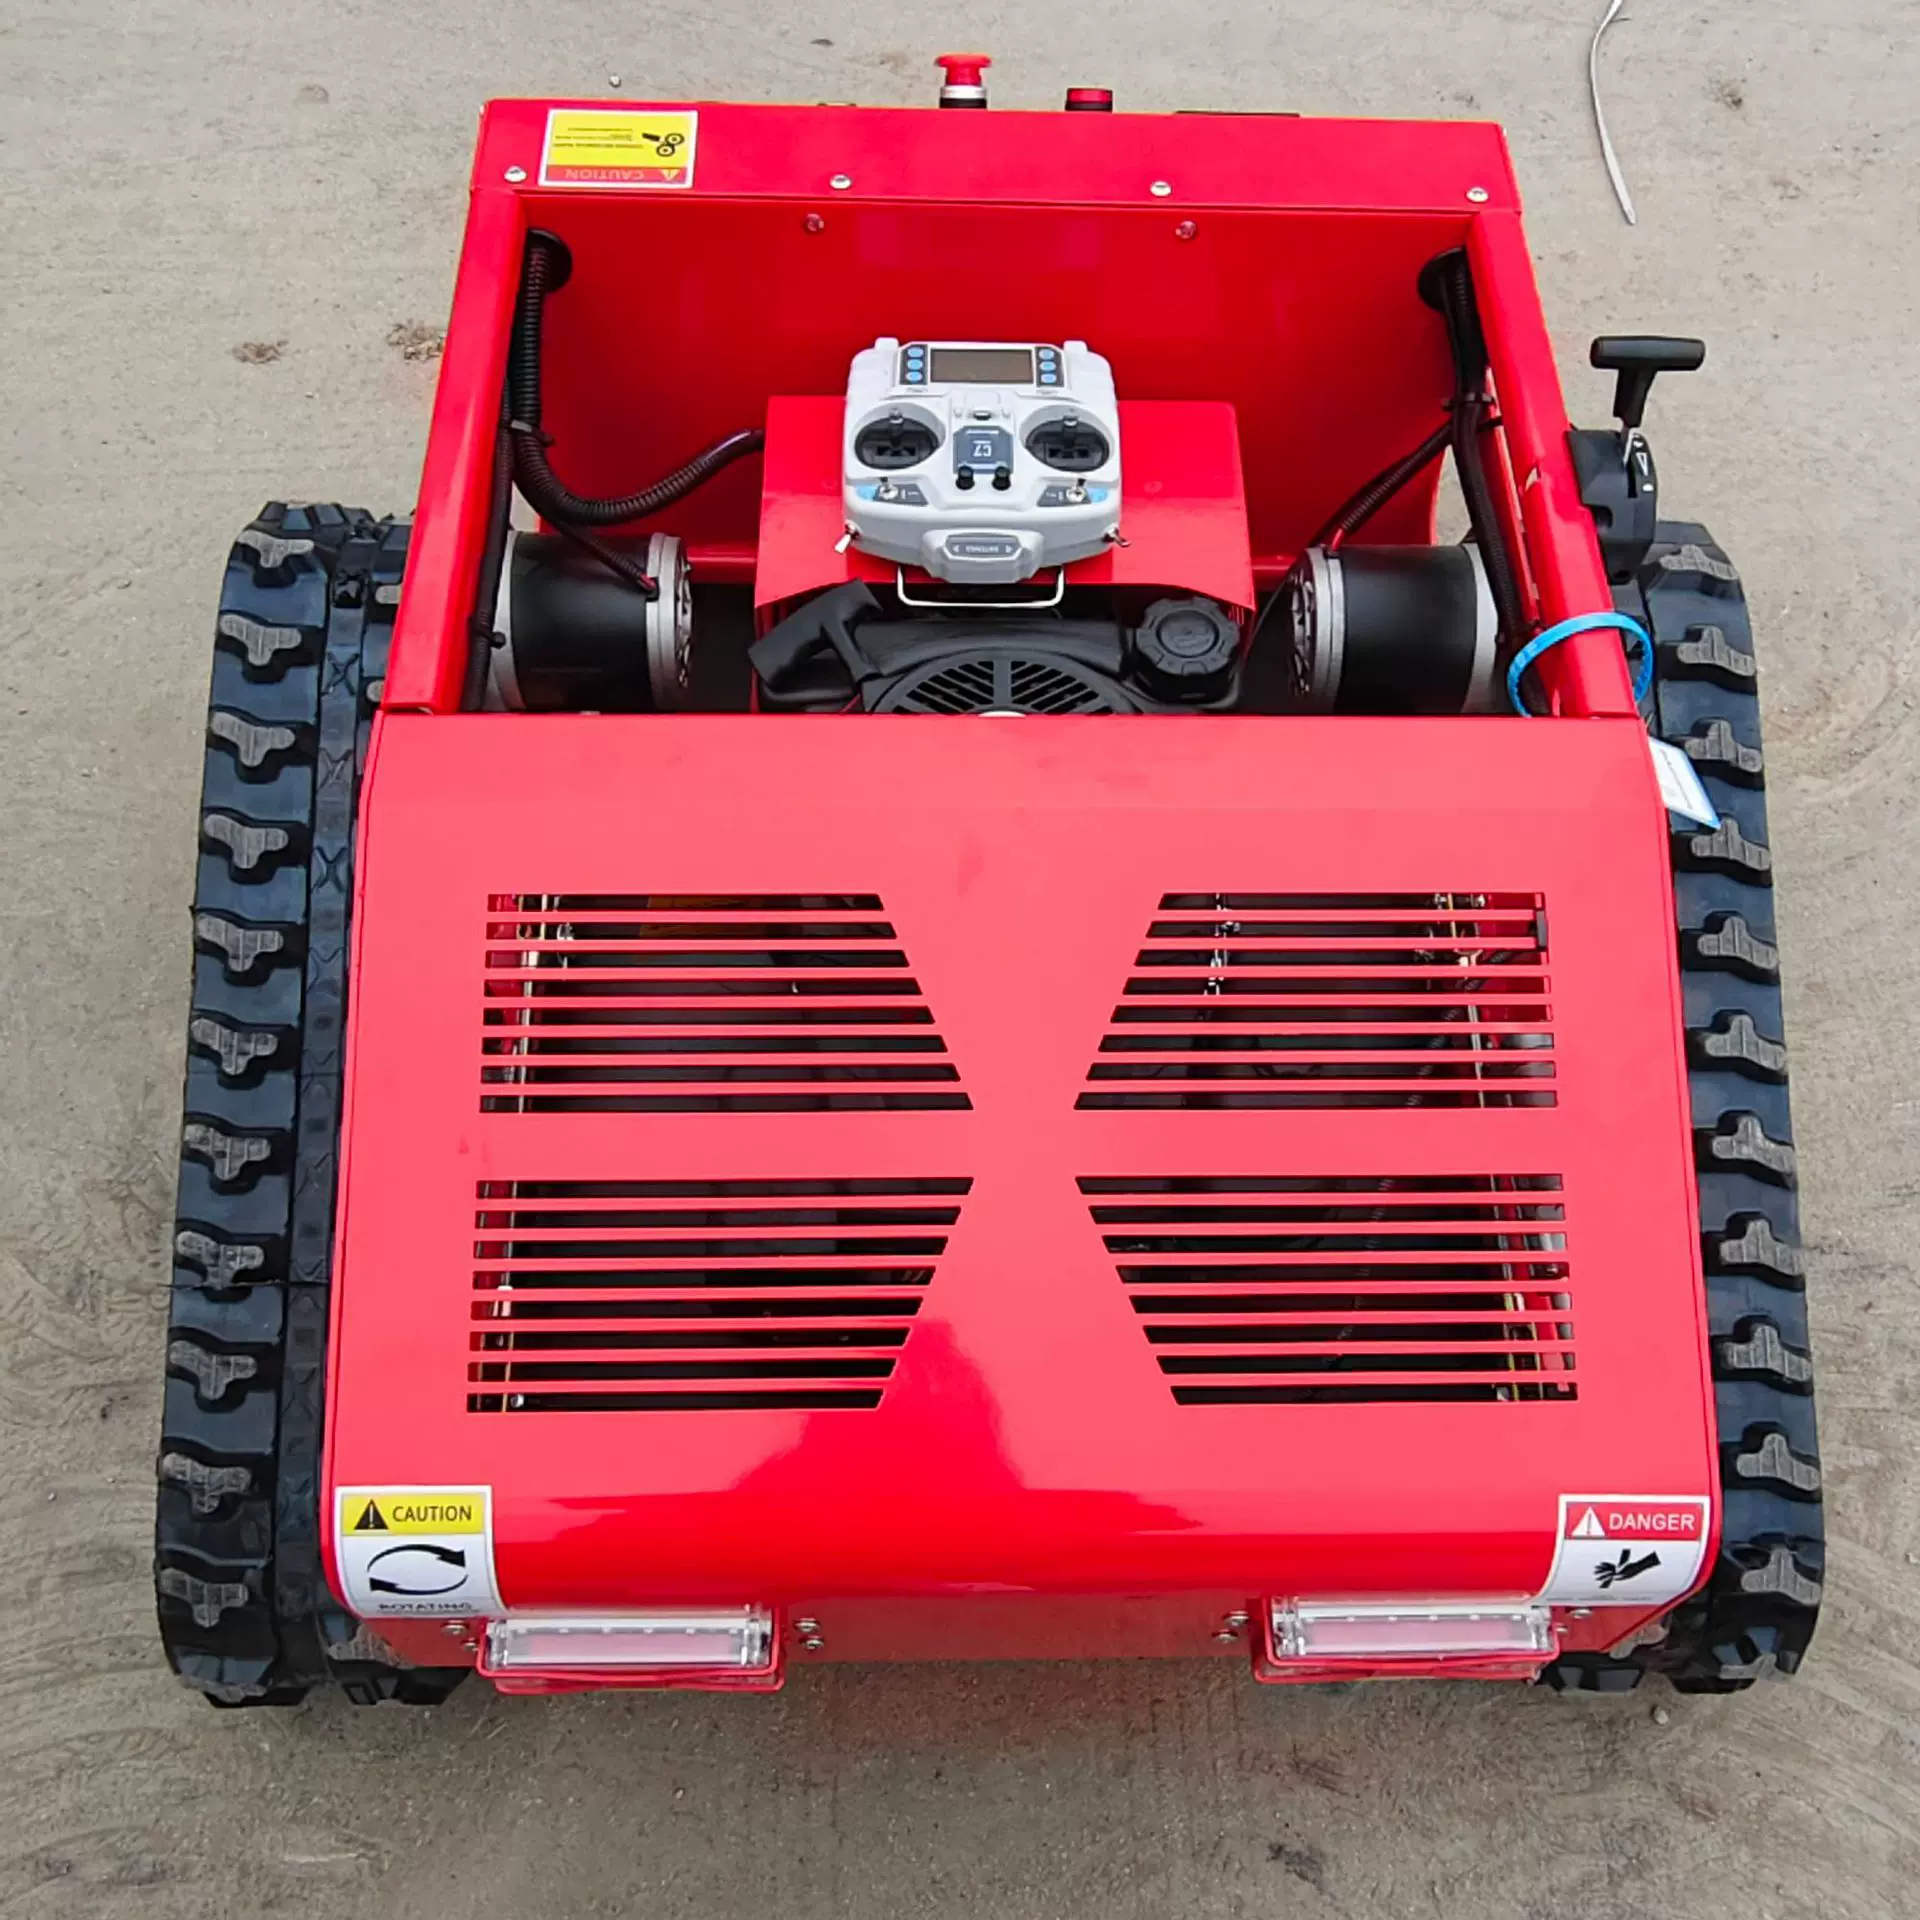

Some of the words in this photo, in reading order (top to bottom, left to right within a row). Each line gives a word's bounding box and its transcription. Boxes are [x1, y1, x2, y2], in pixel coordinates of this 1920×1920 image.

[565, 169, 645, 181] CAUTION
[973, 444, 992, 457] C7
[392, 1505, 473, 1522] CAUTION
[1609, 1513, 1695, 1531] DANGER
